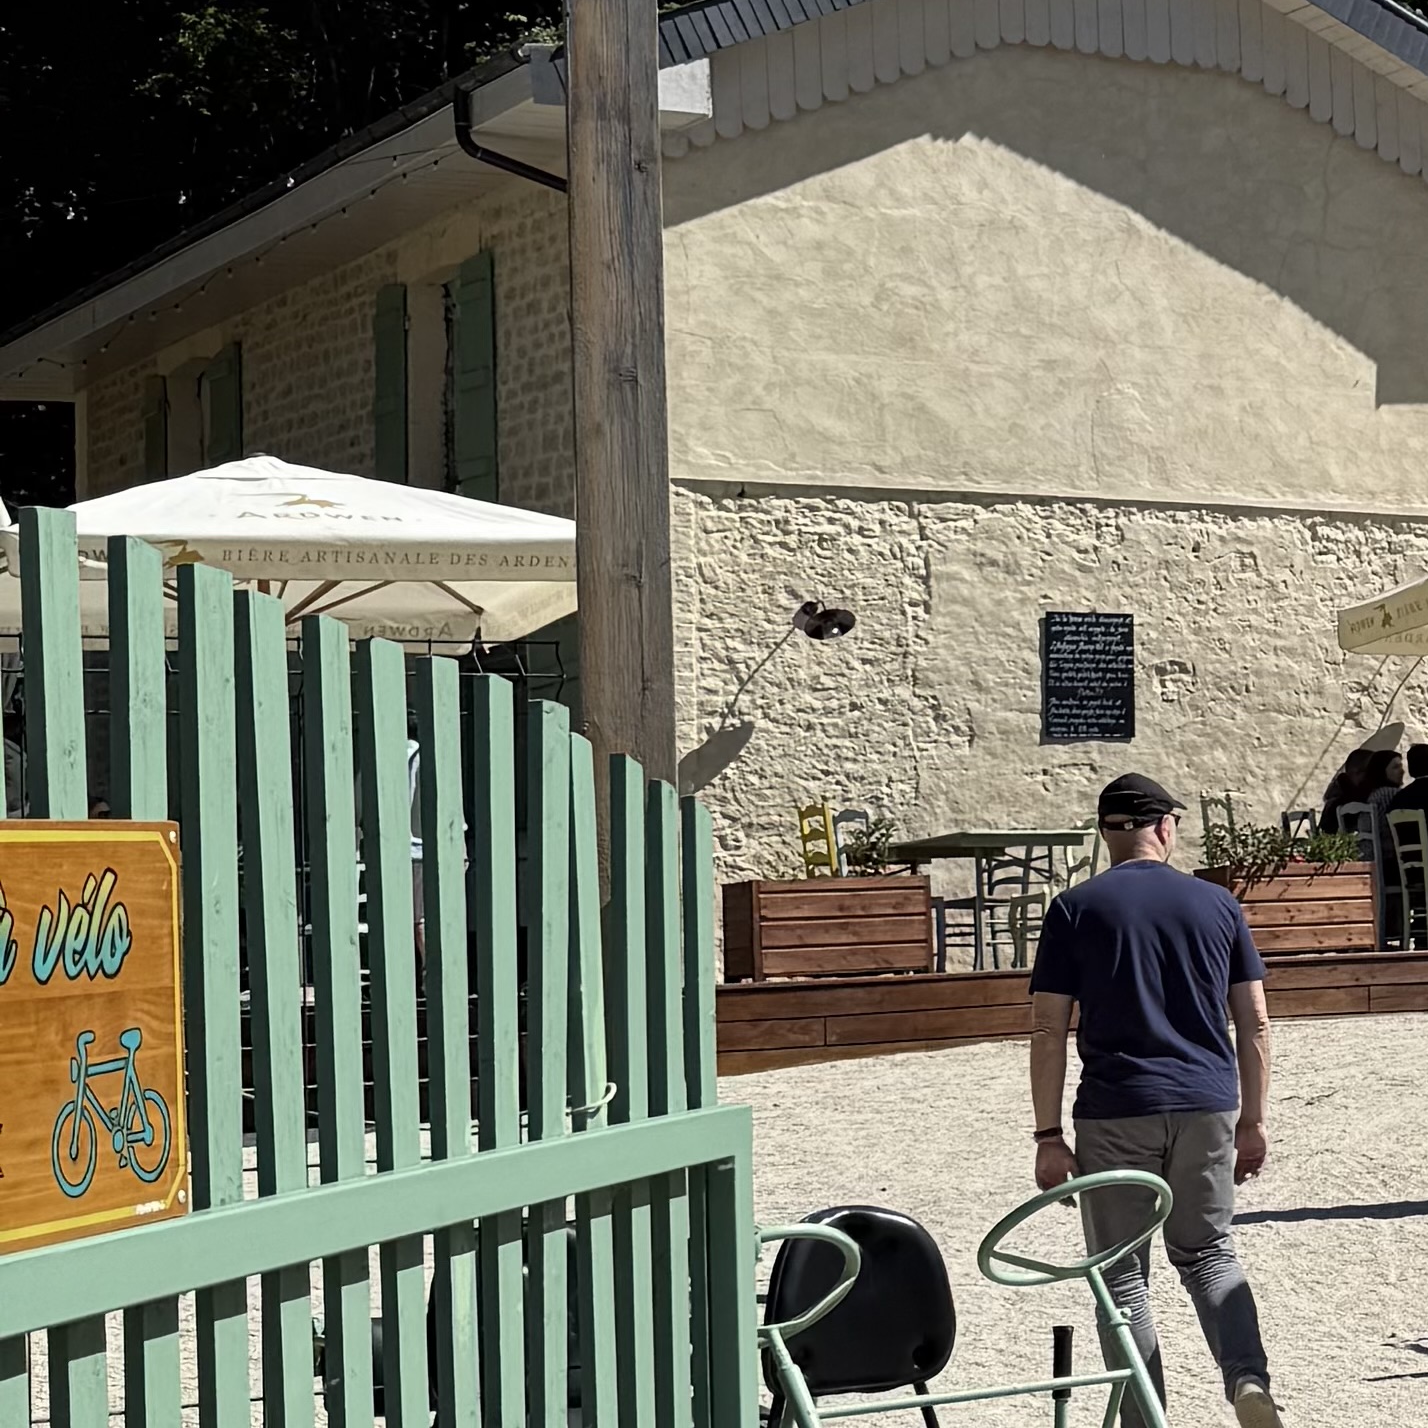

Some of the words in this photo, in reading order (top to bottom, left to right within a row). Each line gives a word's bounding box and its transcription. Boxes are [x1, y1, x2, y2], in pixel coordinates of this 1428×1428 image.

[221, 546, 289, 564] BIÈRE
[299, 548, 440, 566] ARTISANALE
[450, 552, 489, 567] DES
[498, 553, 577, 568] ARDEN
[32, 866, 134, 986] vélo
